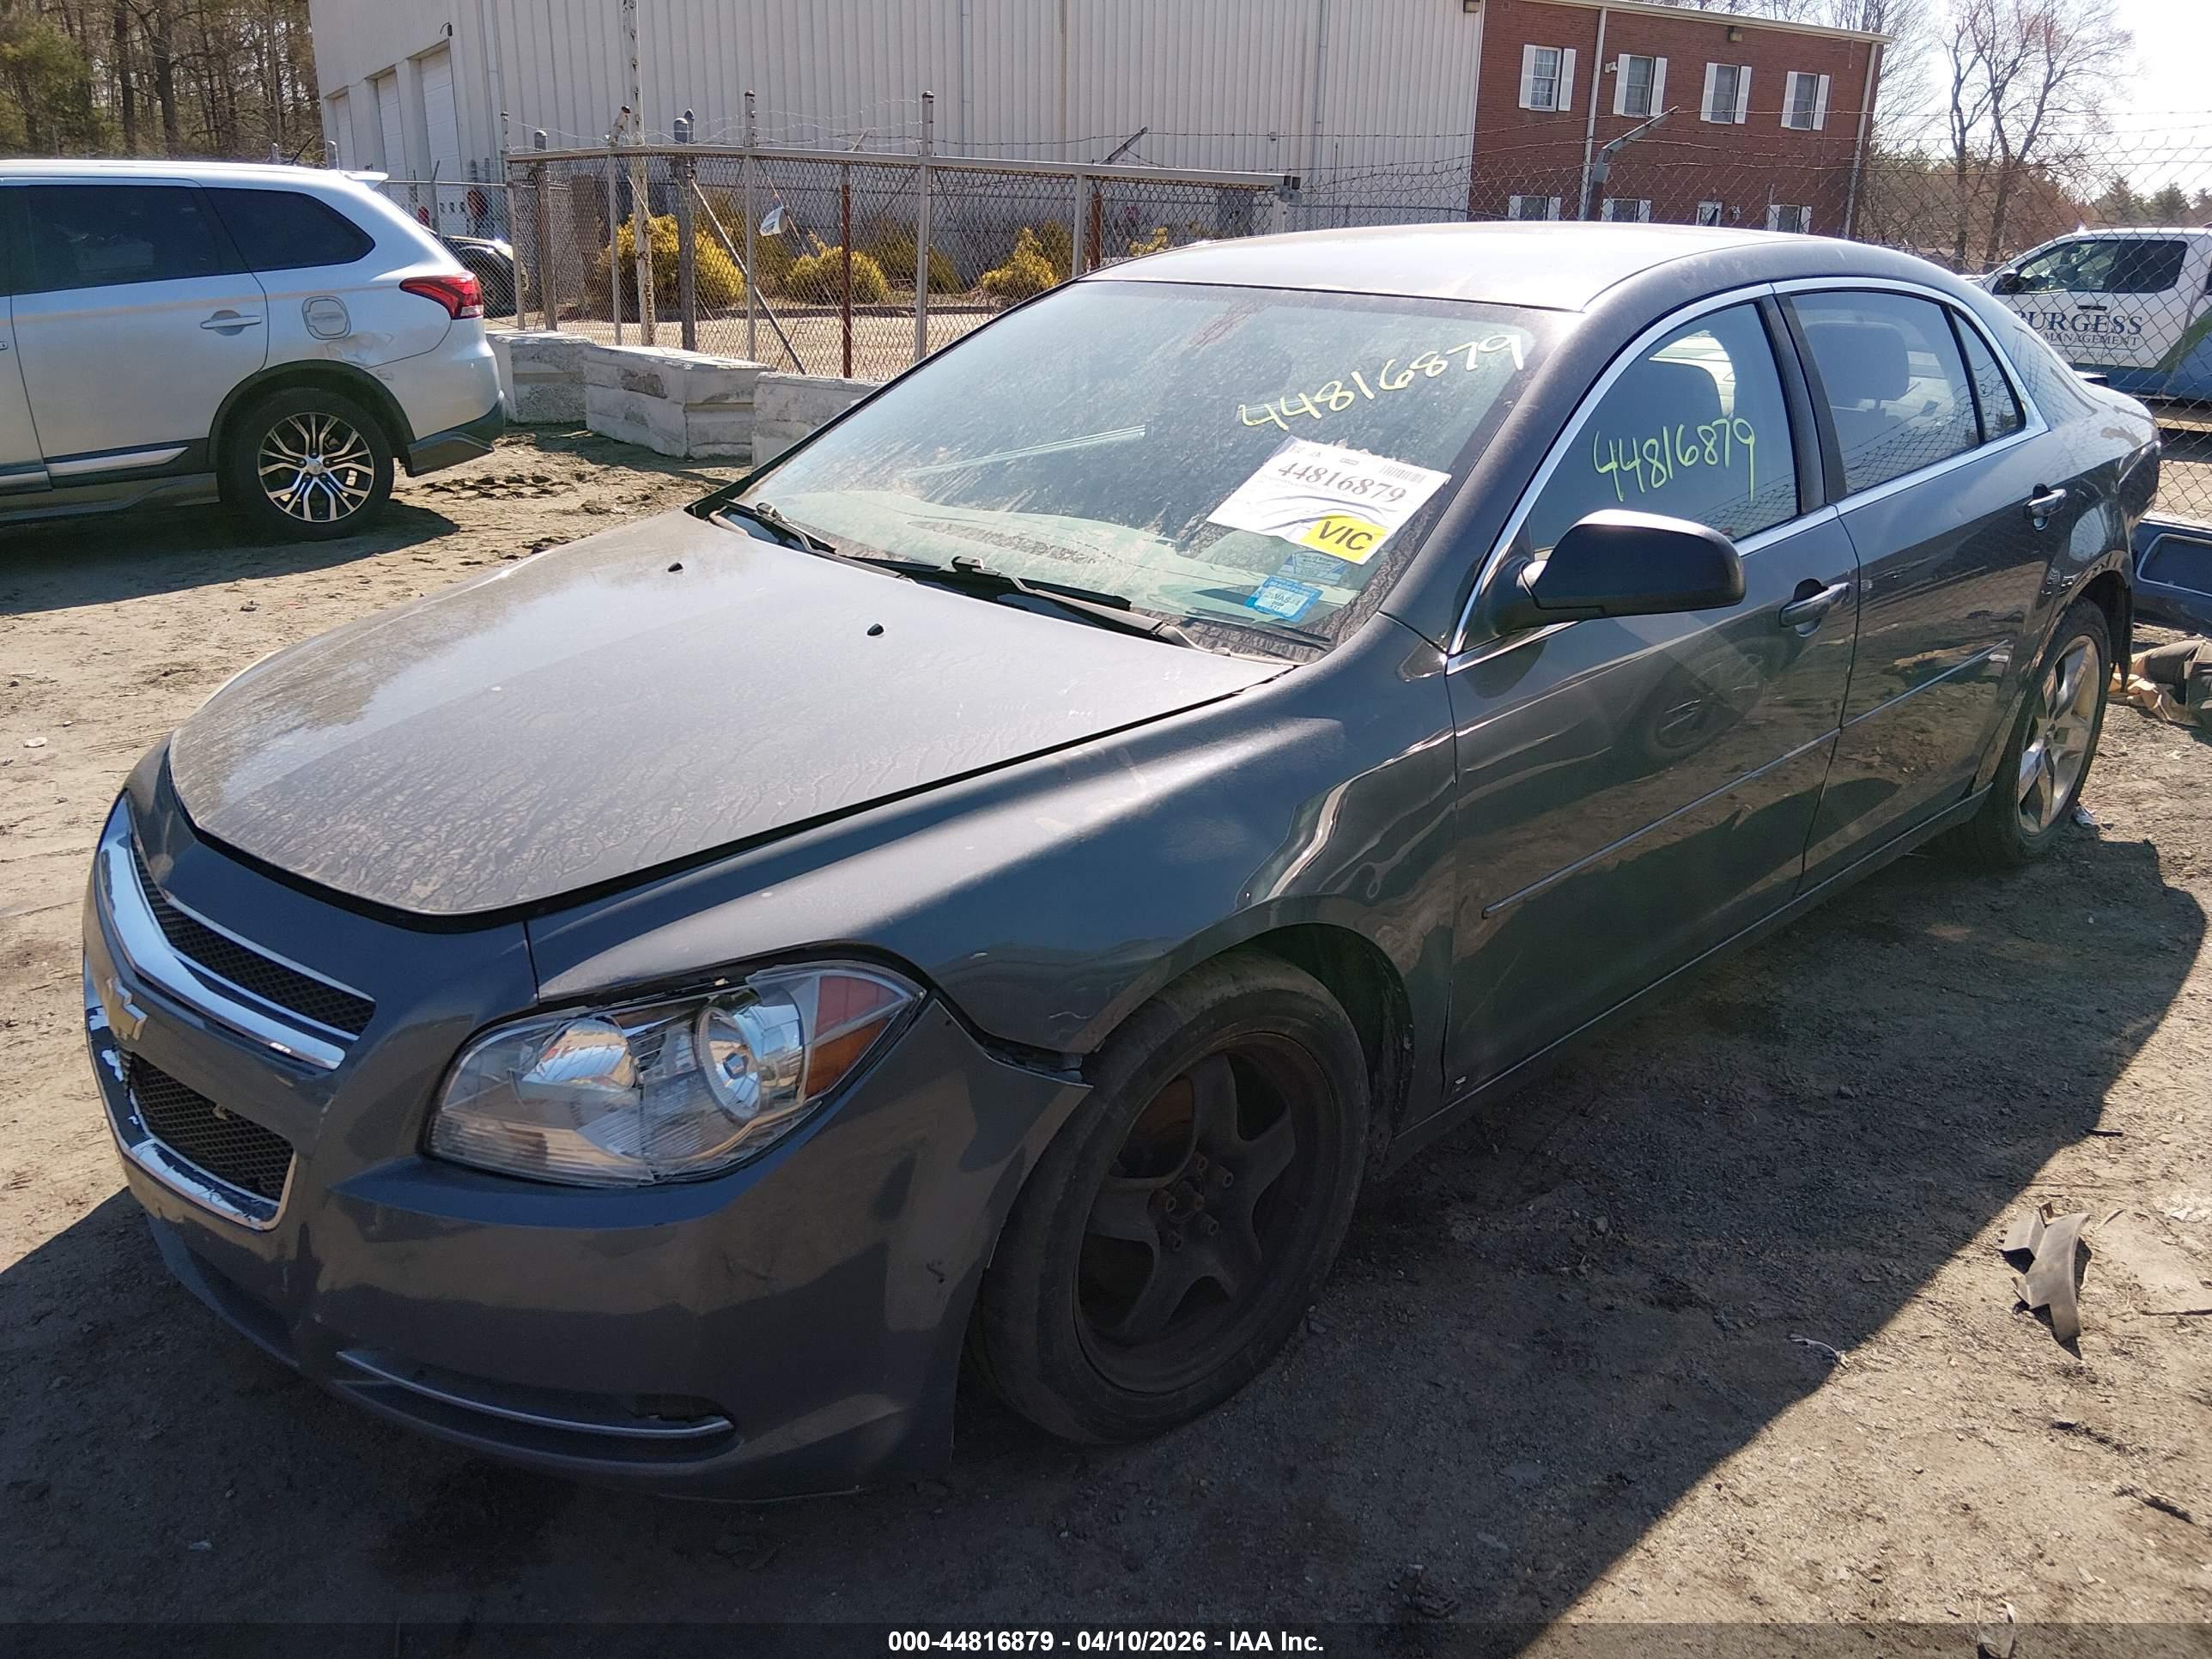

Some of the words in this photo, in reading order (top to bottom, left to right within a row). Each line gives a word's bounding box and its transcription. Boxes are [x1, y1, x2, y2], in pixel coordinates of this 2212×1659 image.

[1237, 334, 1524, 431] 44816879
[1278, 462, 1407, 502] 44816879
[1593, 417, 1756, 502] 44816879
[1319, 520, 1373, 551] VIC
